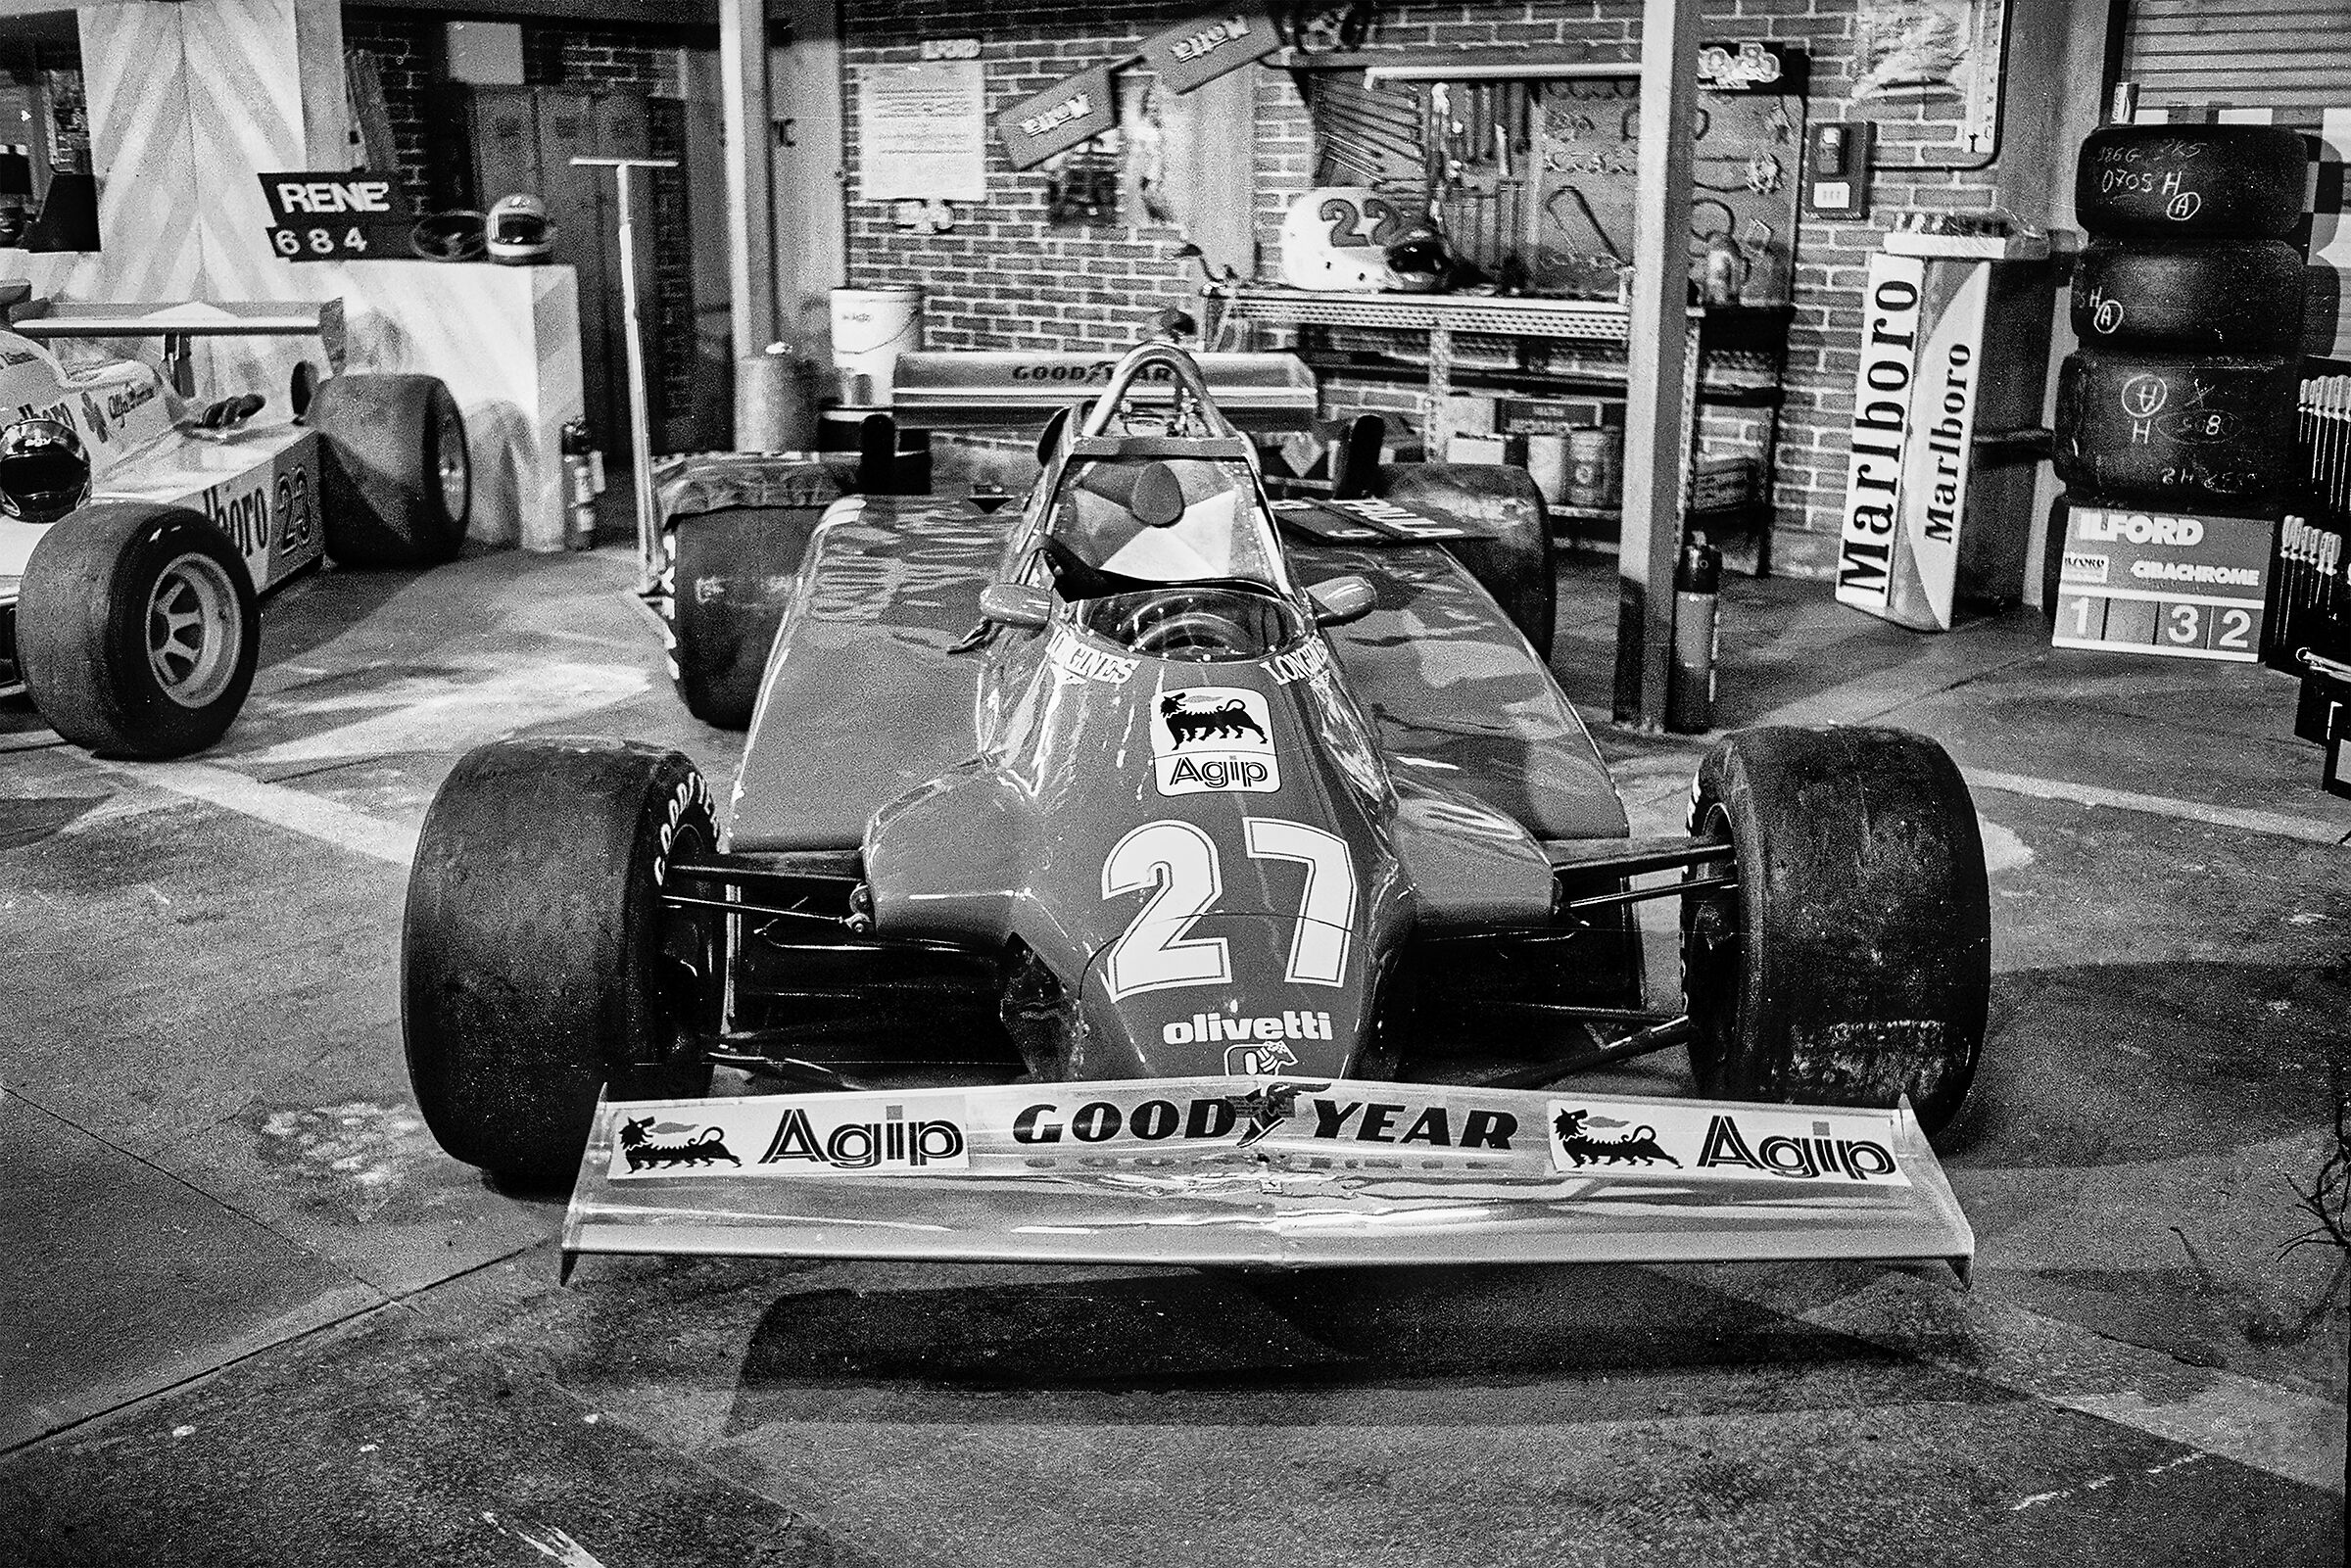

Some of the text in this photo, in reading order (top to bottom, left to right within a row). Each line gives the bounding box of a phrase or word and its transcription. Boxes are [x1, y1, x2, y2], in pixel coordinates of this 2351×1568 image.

[276, 181, 390, 214] RENE
[1012, 365, 1087, 381] GOOD
[1840, 279, 1918, 594] Marlboro
[1924, 343, 1972, 544] Marlboro
[2132, 418, 2152, 445] H
[2079, 513, 2204, 546] ILFORD
[2069, 596, 2090, 635] 1
[1169, 754, 1270, 788] Agip
[1100, 816, 1359, 1005] 27
[1163, 1010, 1333, 1045] olivetti
[757, 1098, 1897, 1181] Agip GOOD YEAR Agip
